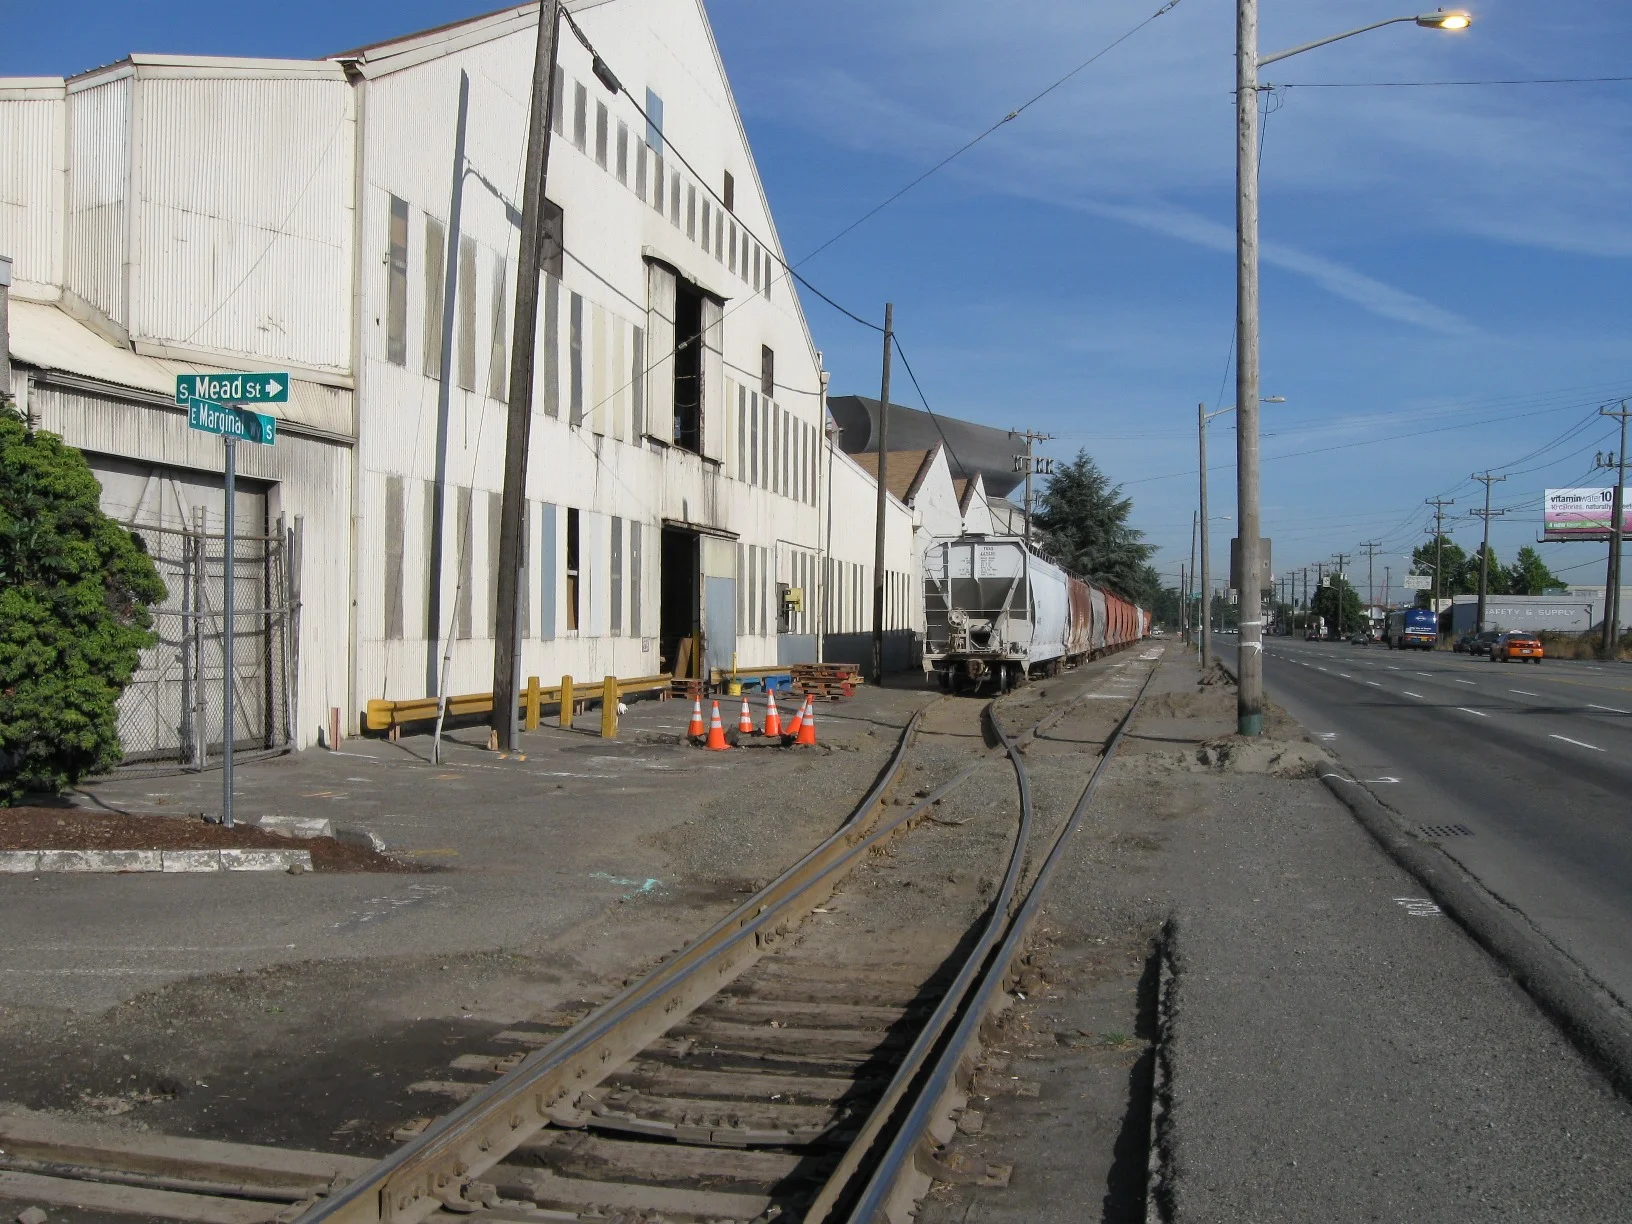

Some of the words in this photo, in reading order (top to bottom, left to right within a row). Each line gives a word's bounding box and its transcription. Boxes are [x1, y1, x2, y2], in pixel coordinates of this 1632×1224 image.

[179, 384, 189, 399] S
[195, 376, 242, 399] Mead
[246, 382, 261, 398] St
[191, 407, 197, 424] E
[199, 403, 244, 434] Marginal
[266, 425, 273, 440] S
